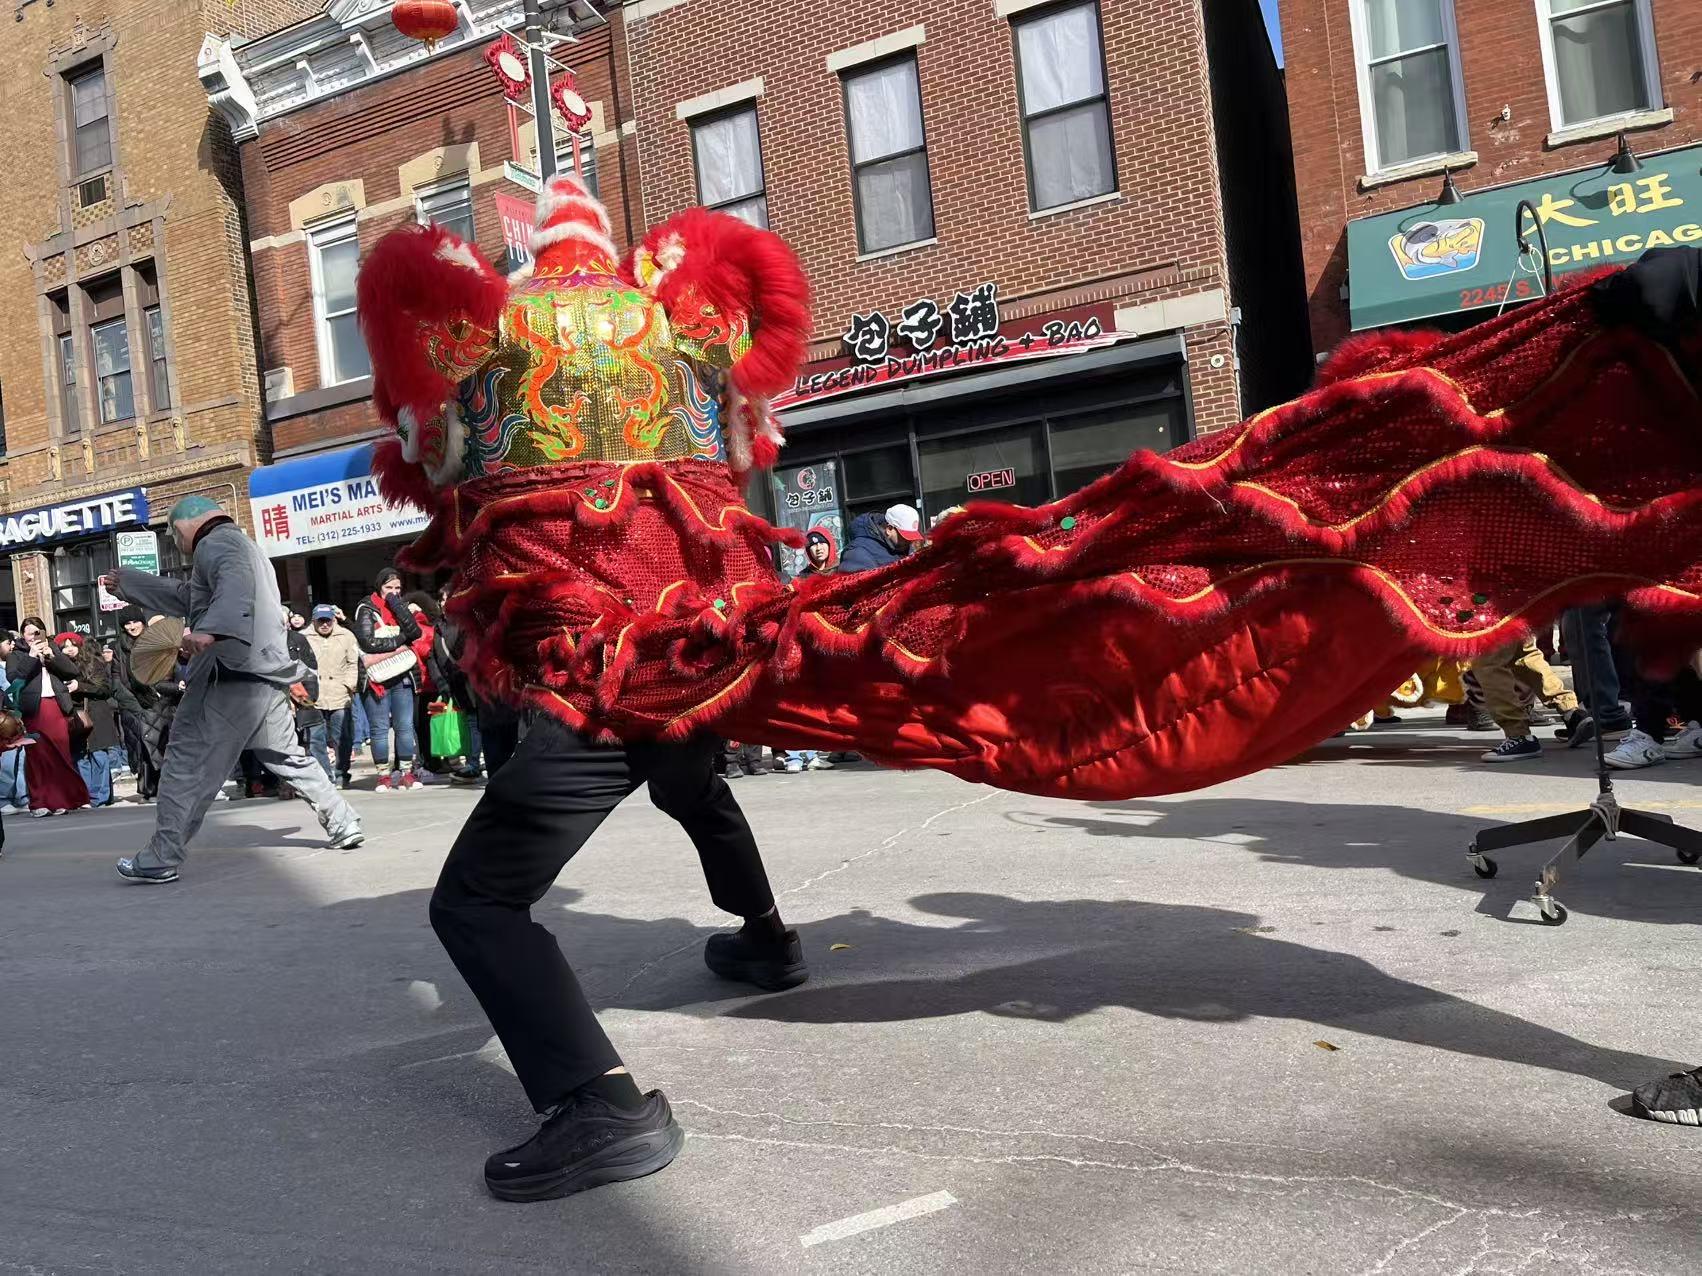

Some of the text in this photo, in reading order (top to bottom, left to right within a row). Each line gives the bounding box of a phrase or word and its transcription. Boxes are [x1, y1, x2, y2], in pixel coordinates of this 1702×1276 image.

[1522, 173, 1684, 236] 大旺
[503, 216, 534, 241] CHIN
[1549, 223, 1702, 265] CHICAG
[1460, 284, 1508, 308] 2245
[795, 316, 1101, 396] LEGEND DUMPLING + BAO
[970, 470, 1013, 490] OPEN
[292, 480, 377, 512] MEI'S MA
[261, 504, 291, 542] 晴
[310, 511, 354, 527] MARTIAL
[357, 503, 383, 518] ARTS
[296, 535, 316, 546] TEL:
[317, 530, 339, 544] (312)
[341, 522, 382, 538] 225-1933
